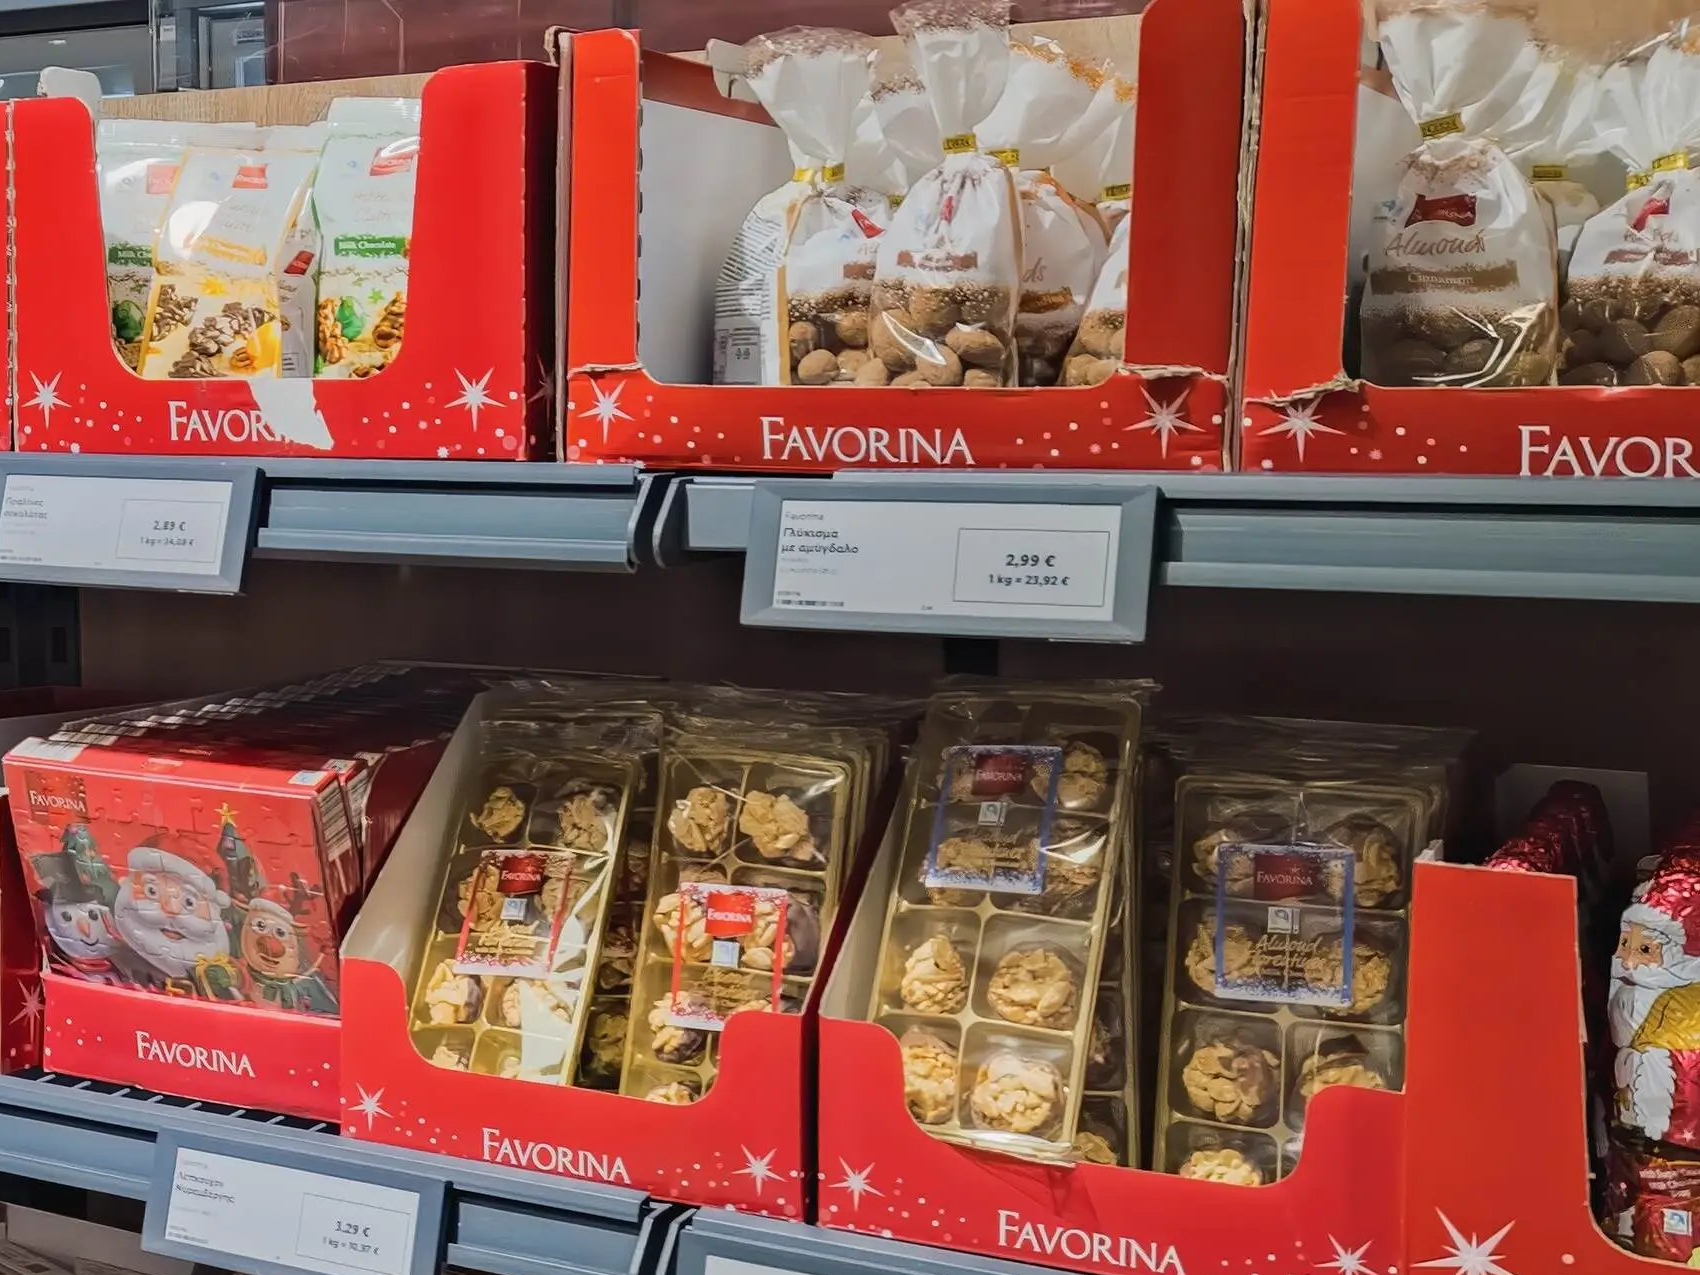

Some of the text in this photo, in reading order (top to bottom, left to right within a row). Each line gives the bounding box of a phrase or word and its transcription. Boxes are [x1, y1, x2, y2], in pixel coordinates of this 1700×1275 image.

[761, 416, 975, 466] FAVORINA
[1005, 554, 1056, 568] 2,99 €
[996, 574, 1013, 587] kg
[1025, 576, 1058, 588] 23,92
[1060, 577, 1071, 587] €
[29, 790, 87, 813] FAVORINA
[136, 1029, 256, 1077] FAVORINA
[481, 1129, 632, 1186] FAVORINA
[362, 1226, 372, 1239] €
